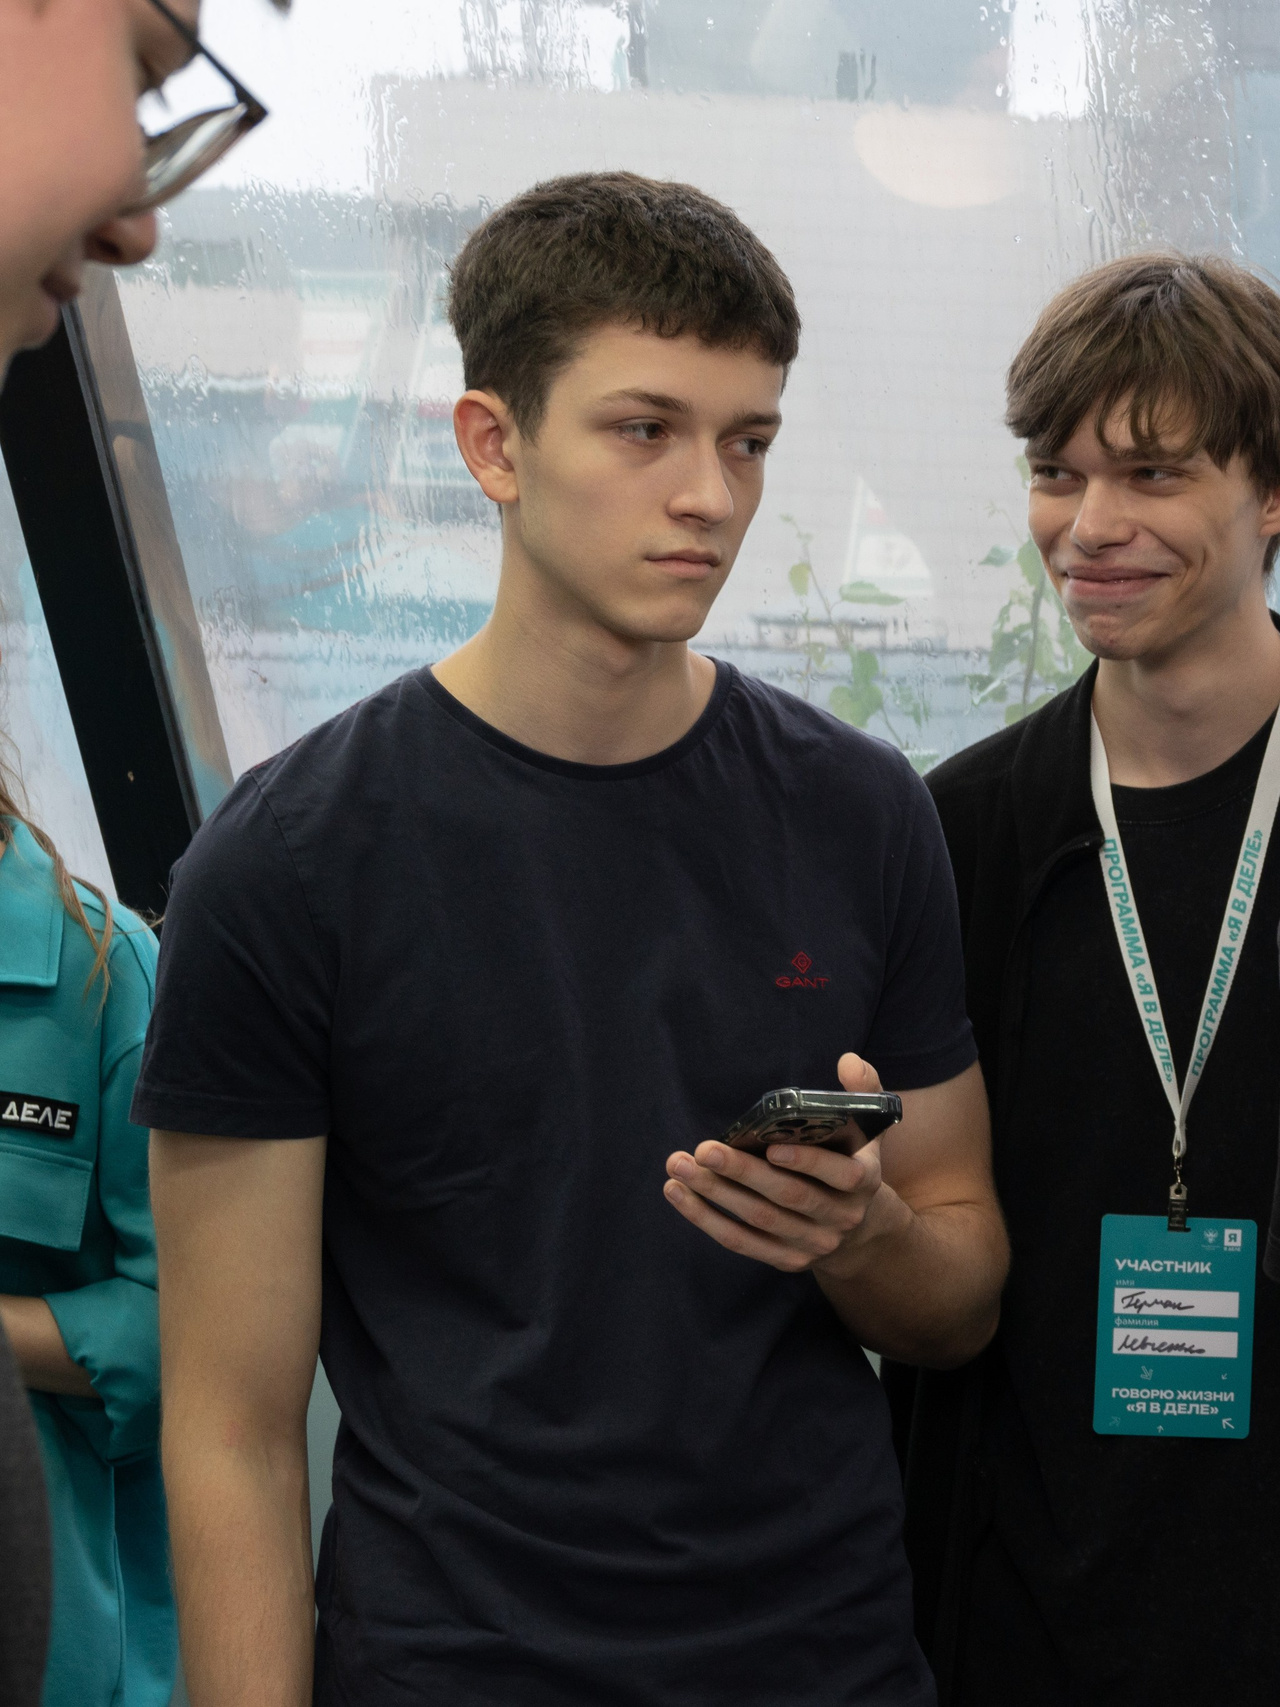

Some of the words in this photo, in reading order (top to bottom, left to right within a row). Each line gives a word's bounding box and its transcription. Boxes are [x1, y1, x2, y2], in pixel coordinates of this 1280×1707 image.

[1236, 829, 1263, 899] ДЕЛЕ»
[1104, 838, 1146, 969] ПРОГРАММА
[1231, 898, 1247, 914] В
[1227, 915, 1243, 942] «Я
[775, 975, 830, 989] GANT
[1135, 972, 1154, 996] «Я
[1142, 1001, 1158, 1013] В
[1191, 945, 1236, 1077] ПРОГРАММА
[1145, 1018, 1174, 1083] ДЕЛЕ»
[1115, 1258, 1212, 1274] УЧАСТНИК
[1115, 1278, 1135, 1286] имя
[1114, 1316, 1159, 1327] фамилия
[1111, 1387, 1174, 1400] ГОВОРЮ
[1176, 1389, 1235, 1402] ЖИЗНИ
[1126, 1402, 1147, 1413] «Я
[1149, 1402, 1161, 1413] В
[1163, 1403, 1219, 1416] ДЕЛЕ»
